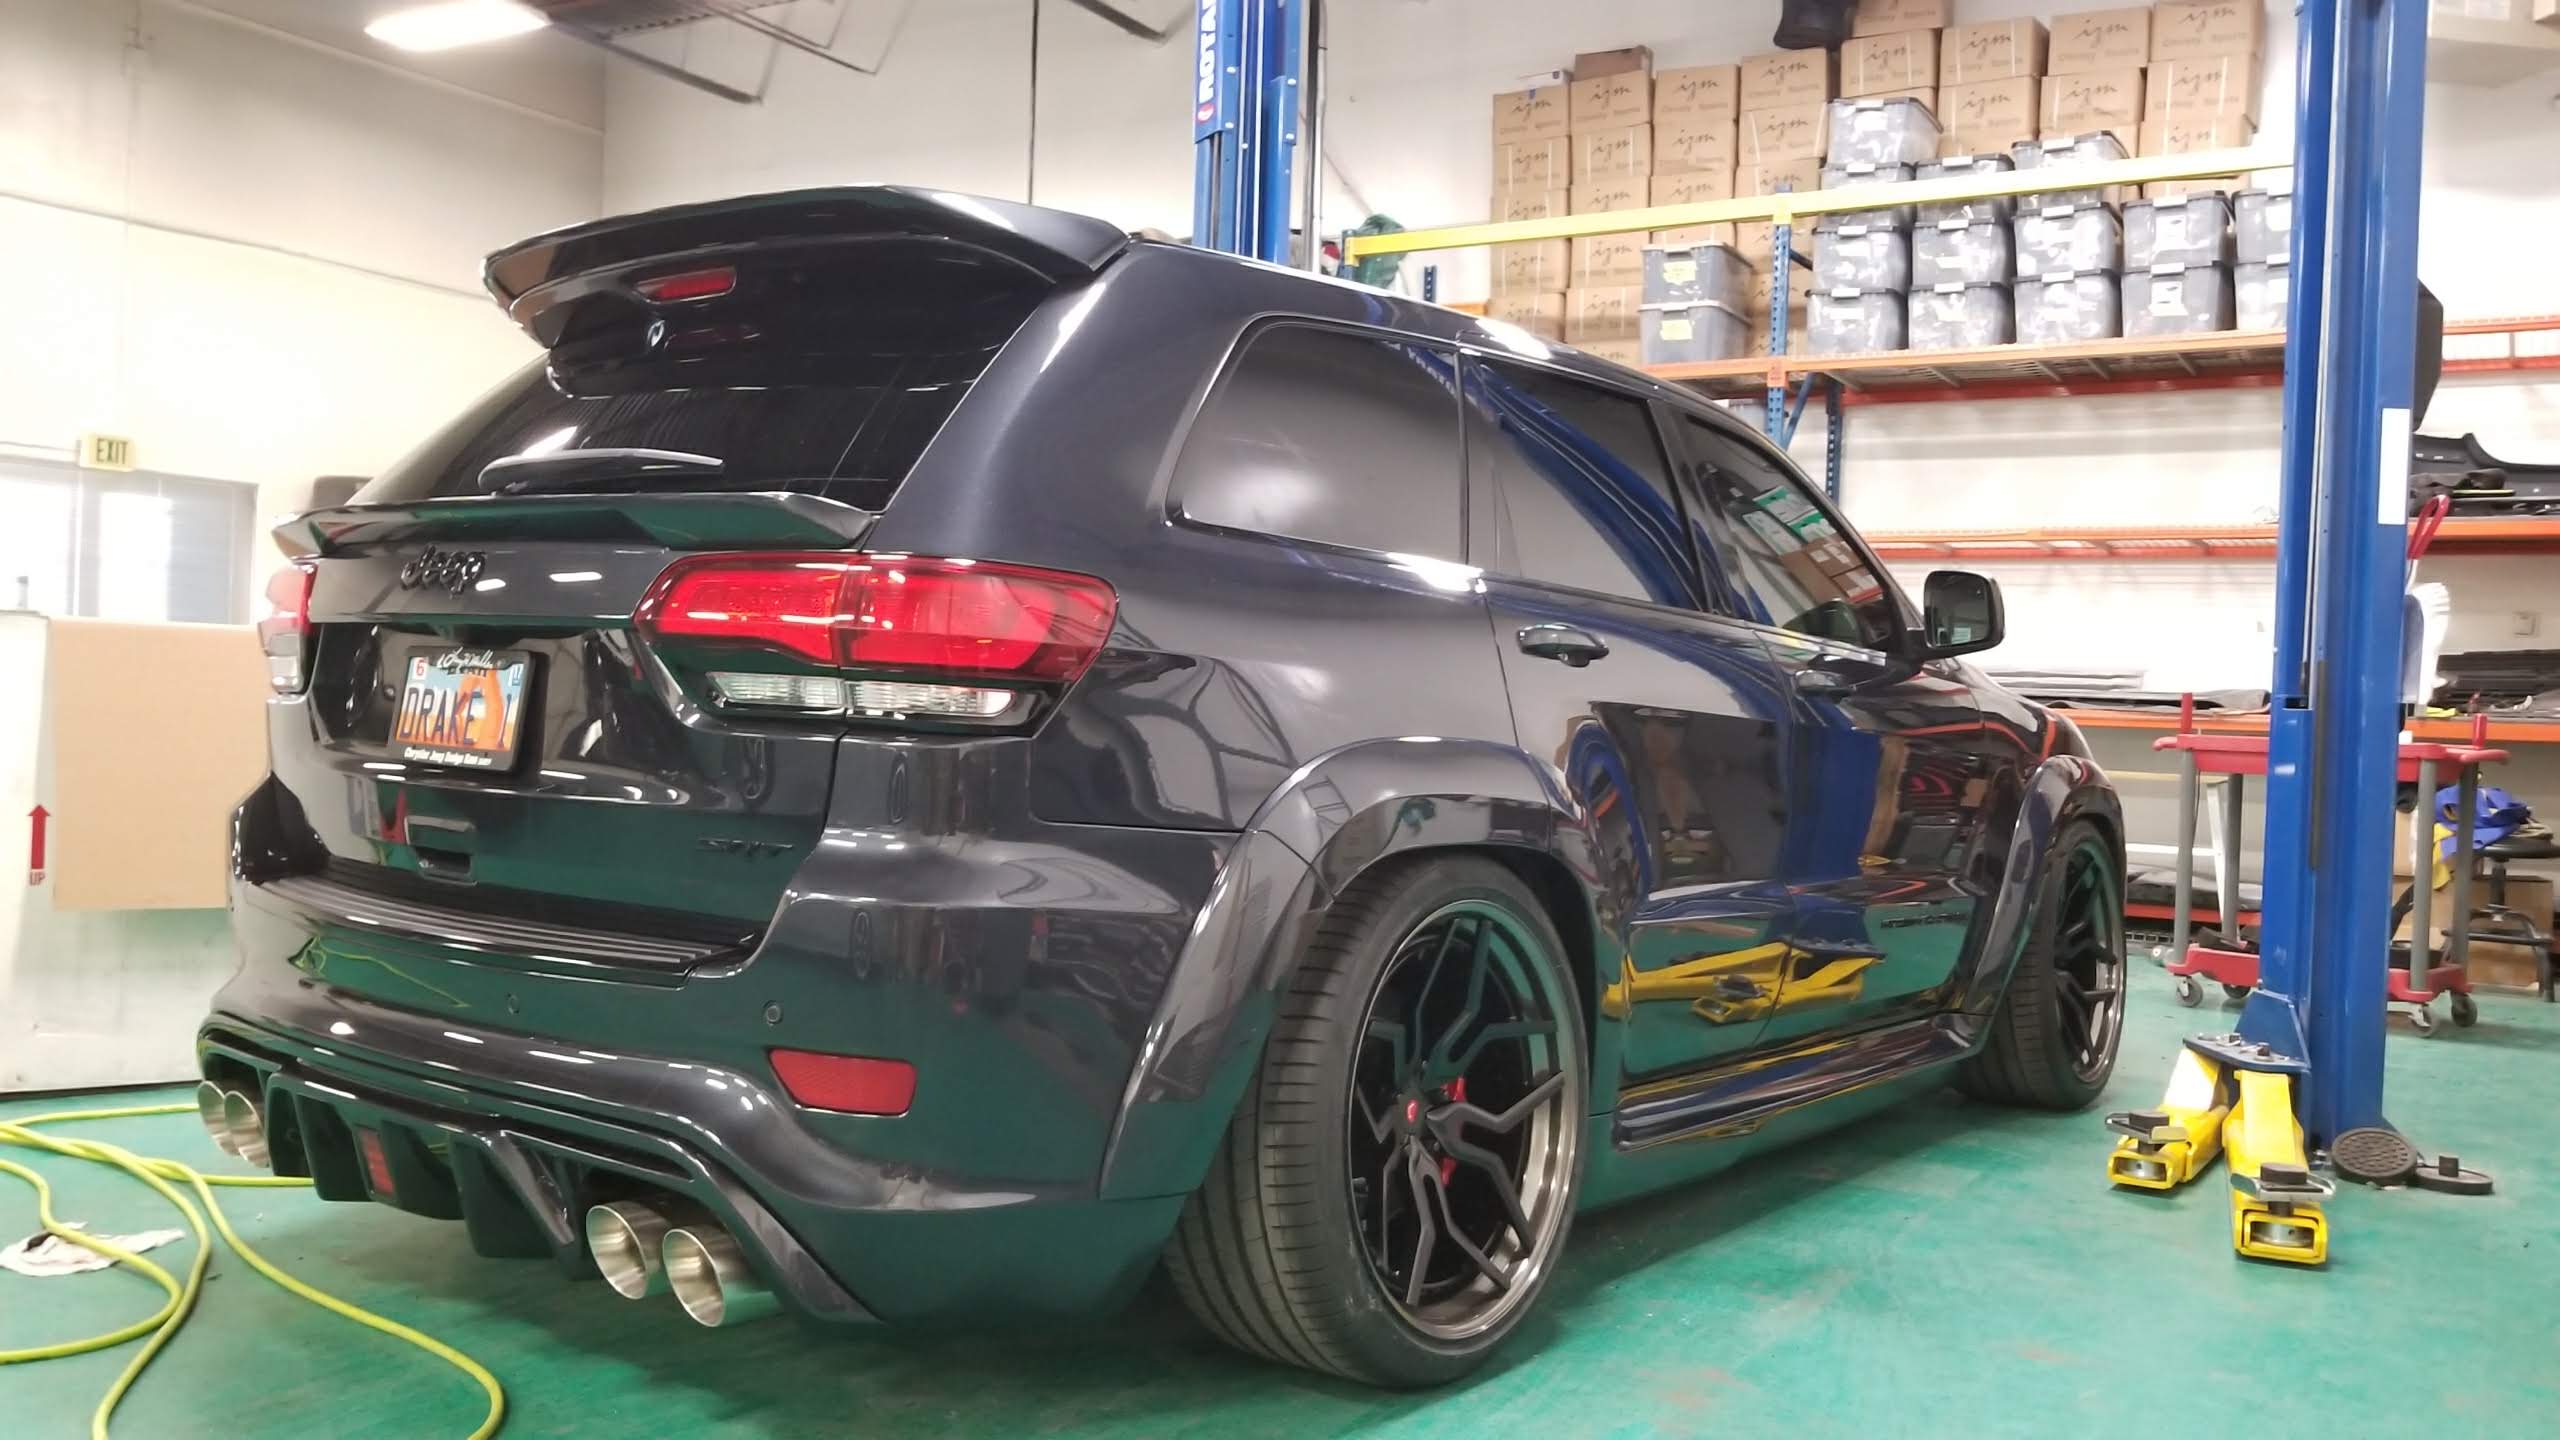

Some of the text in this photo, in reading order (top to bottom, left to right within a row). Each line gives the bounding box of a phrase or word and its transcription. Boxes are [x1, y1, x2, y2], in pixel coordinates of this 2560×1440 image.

[96, 437, 129, 465] EXIT
[400, 543, 488, 600] Jeep
[416, 658, 425, 677] 6
[400, 686, 485, 746] DRAKE
[29, 871, 46, 887] UP
